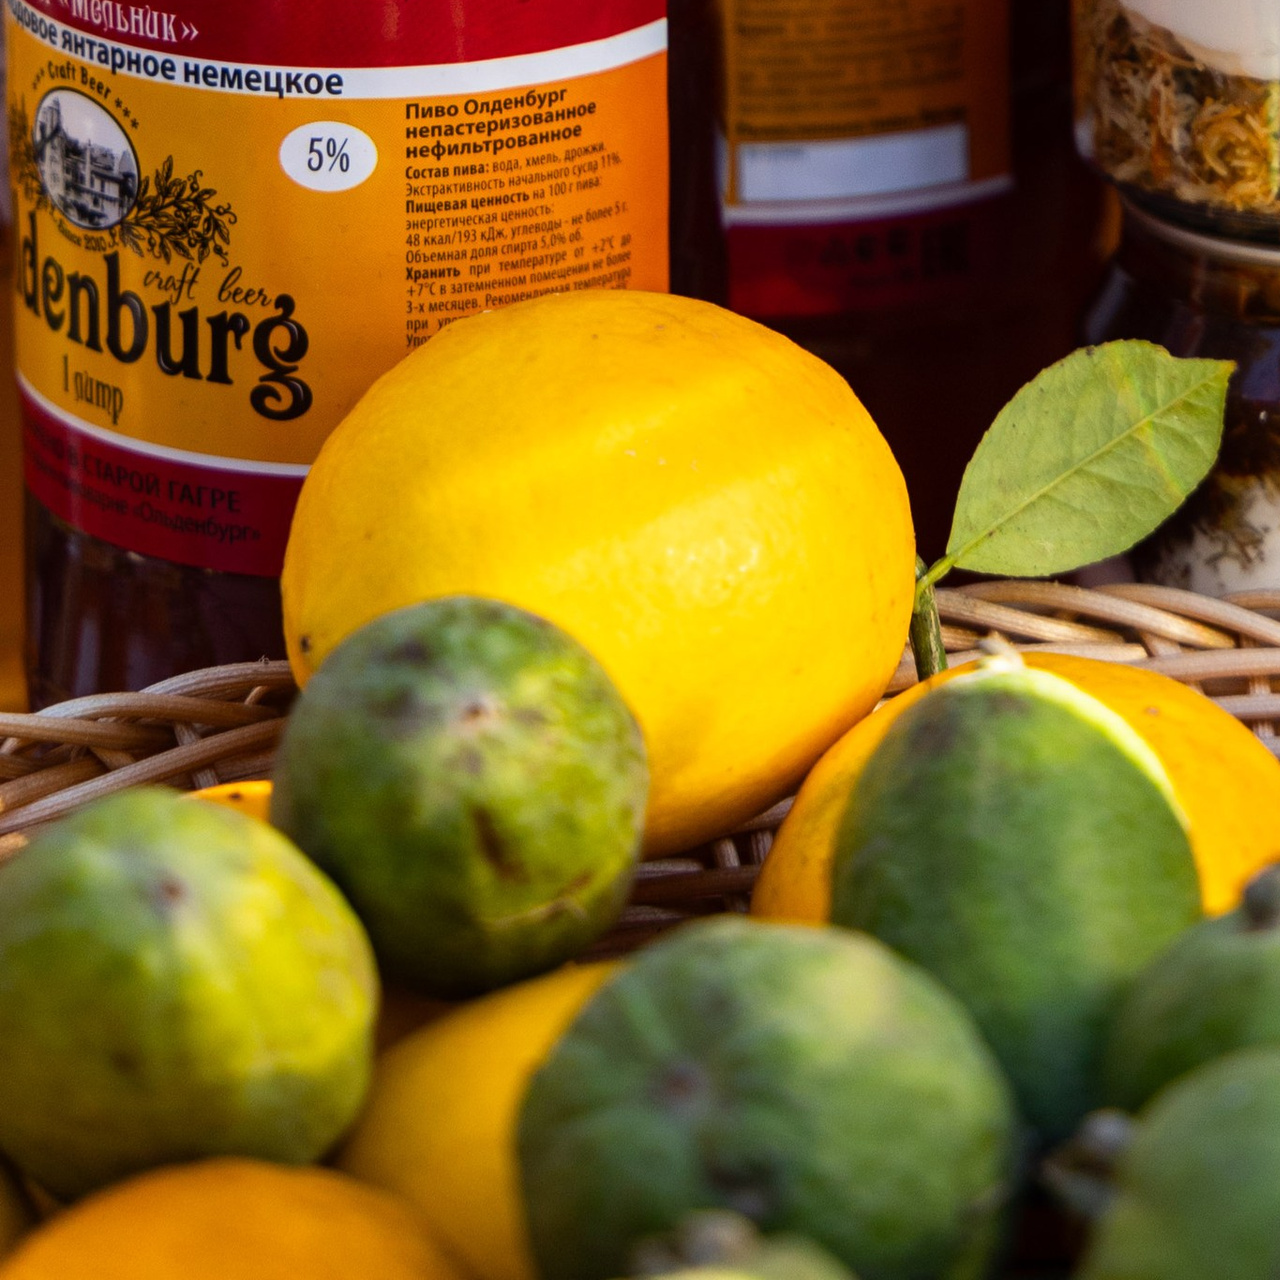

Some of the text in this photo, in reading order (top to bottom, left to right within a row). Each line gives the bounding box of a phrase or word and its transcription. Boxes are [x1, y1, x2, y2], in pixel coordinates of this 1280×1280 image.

[61, 29, 177, 80] янтарное
[184, 61, 344, 100] немецкое
[80, 66, 111, 99] Beer
[405, 88, 567, 120] Пиво Олденбург
[405, 101, 597, 139] непастеризованное
[307, 137, 350, 173] 5%
[405, 124, 582, 161] нефильтрованное
[405, 165, 450, 180] Состав
[453, 162, 490, 177] пива:
[492, 157, 522, 173] вода,
[406, 178, 505, 198] Экстрактивность
[508, 166, 570, 187] начального
[572, 160, 599, 177] сусла
[406, 199, 467, 214] Пищевая
[470, 190, 530, 211] ценность
[533, 188, 545, 200] на
[549, 181, 567, 197] 100
[405, 233, 420, 247] 48
[423, 228, 477, 246] ккал/193
[511, 218, 562, 240] углеводы
[406, 202, 554, 233] энергетическая ценность:
[405, 248, 467, 264] Объемная
[470, 244, 498, 261] доля
[501, 239, 538, 256] спирта
[405, 266, 461, 283] Хранить
[470, 263, 491, 278] при
[499, 250, 567, 274] температуре
[143, 262, 273, 308] craft beer
[440, 284, 447, 295] в
[450, 274, 527, 295] затемненном
[530, 261, 590, 284] помещении
[406, 300, 425, 314] 3-х
[428, 297, 481, 312] месяцев.
[406, 318, 428, 333] при
[83, 453, 160, 497] СТАРОЙ
[168, 482, 241, 513] ГАГРЕ
